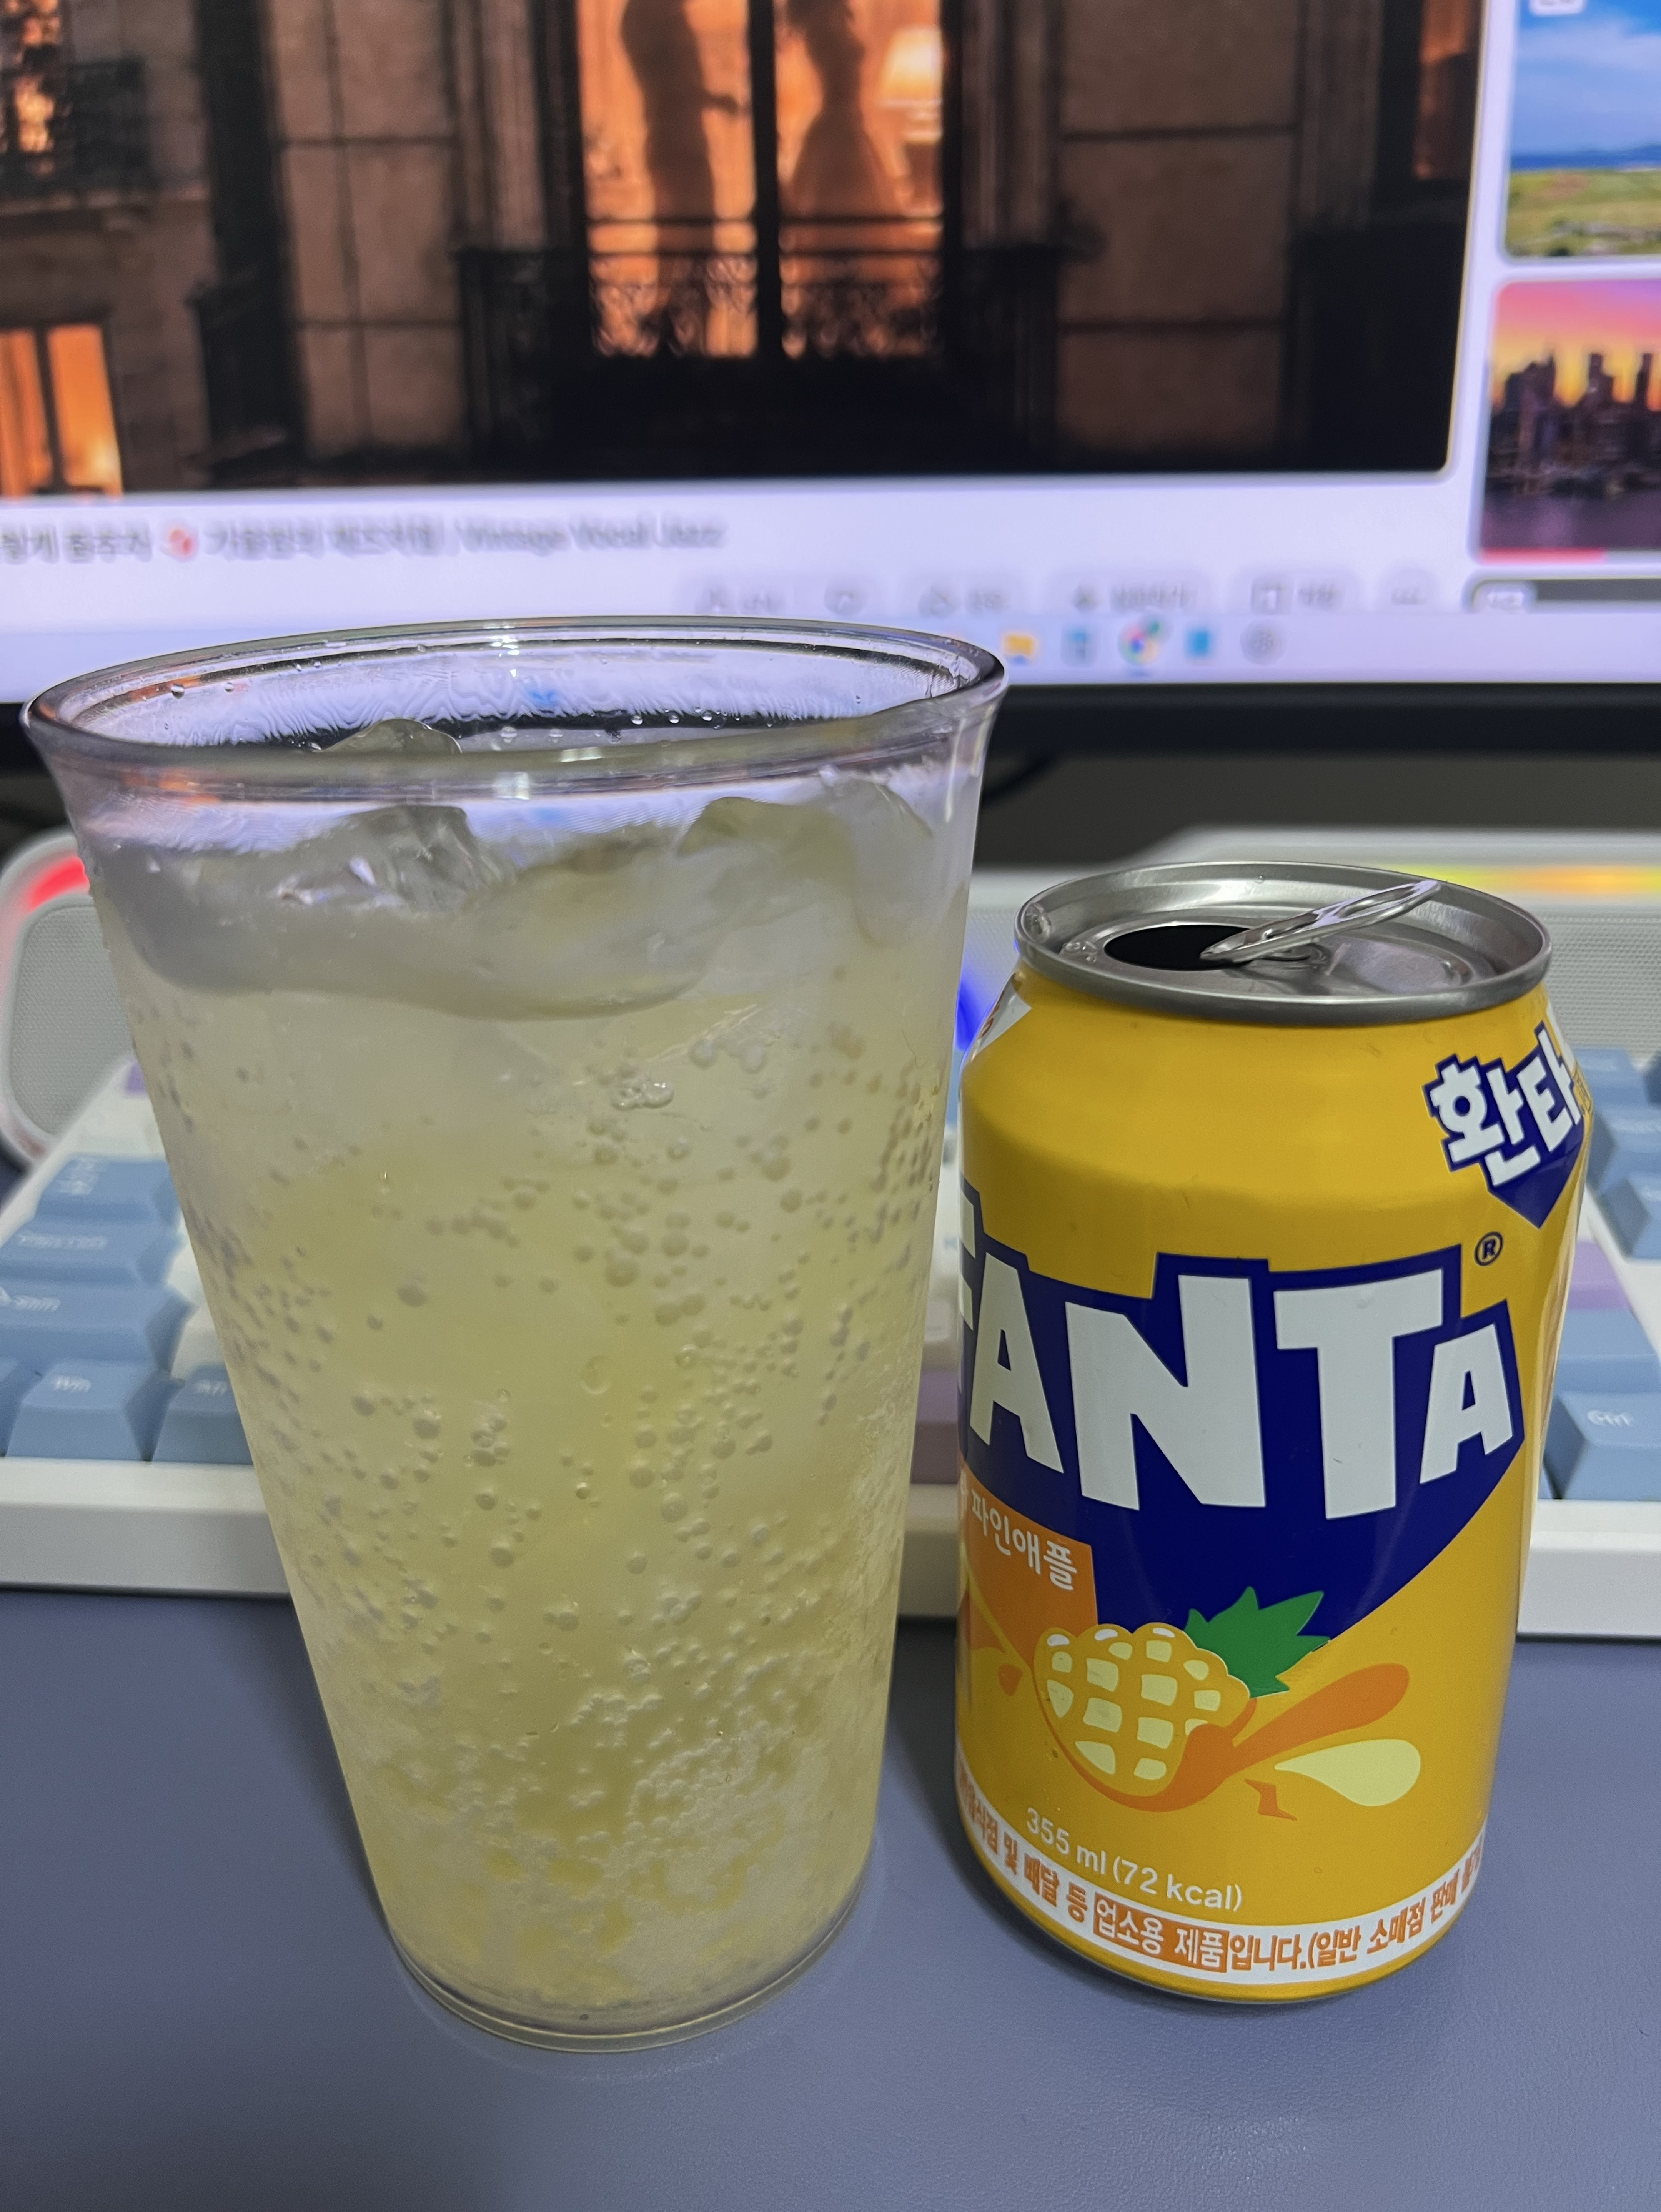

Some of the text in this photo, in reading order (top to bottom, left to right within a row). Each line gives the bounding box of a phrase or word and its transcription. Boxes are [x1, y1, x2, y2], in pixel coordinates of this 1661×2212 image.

[1429, 1029, 1581, 1187] 환타
[971, 1489, 1077, 1590] 파인애플
[1004, 1831, 1018, 1875] 및
[1024, 1853, 1059, 1907] 배달
[1066, 1882, 1087, 1923] 등
[1097, 1899, 1164, 1954] 업소용
[1366, 1896, 1426, 1954] 소매점
[1430, 1868, 1460, 1923] 판매
[1027, 1807, 1242, 1912] 355 ml (72 kcal)
